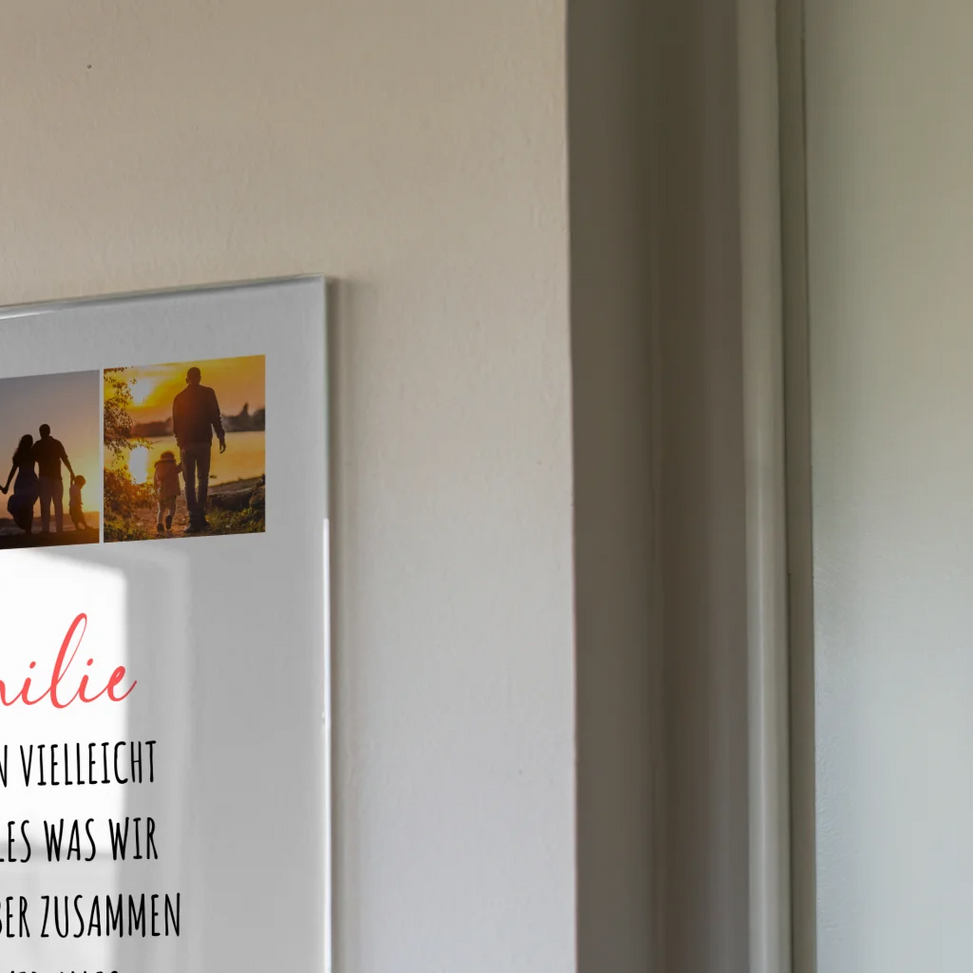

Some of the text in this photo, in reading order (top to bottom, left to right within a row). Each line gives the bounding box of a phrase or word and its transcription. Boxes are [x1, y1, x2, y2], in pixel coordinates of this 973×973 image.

[19, 739, 157, 787] VIELLEICHT
[43, 818, 97, 862] WAS
[108, 816, 159, 861] WIR
[40, 892, 181, 939] ZUSAMMEN
